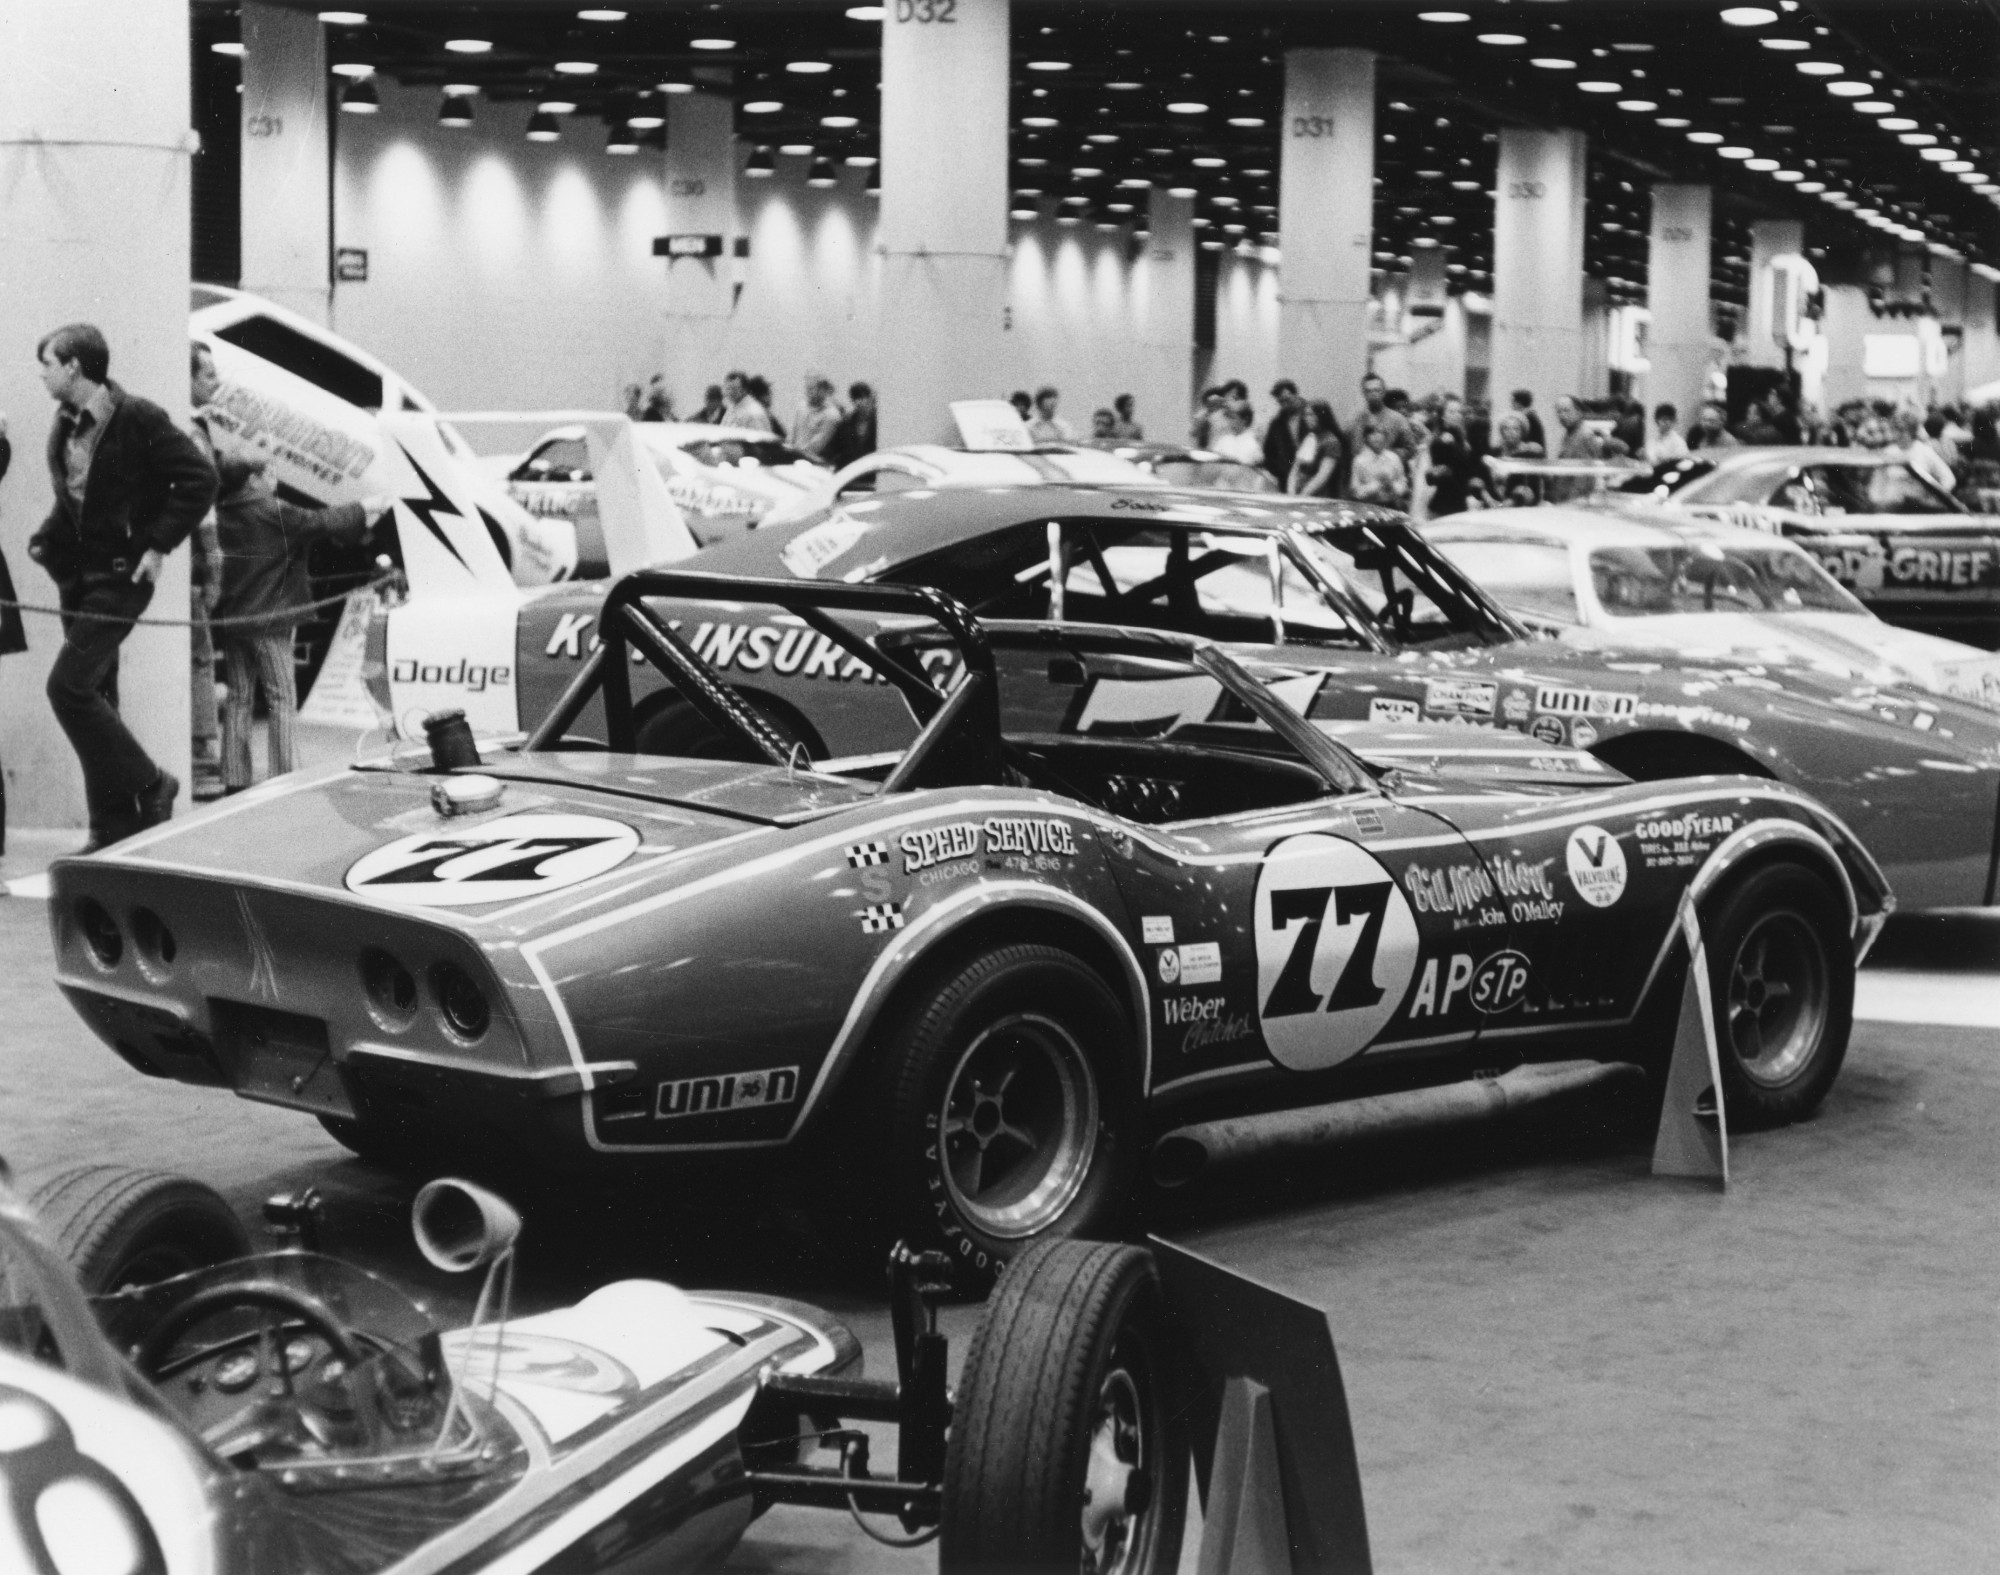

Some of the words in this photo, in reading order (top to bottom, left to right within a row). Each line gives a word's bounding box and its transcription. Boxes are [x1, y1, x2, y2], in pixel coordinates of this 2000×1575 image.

[897, 0, 956, 23] D32
[1892, 547, 1990, 584] GRIEF
[393, 657, 509, 692] Dodge
[1375, 701, 1414, 714] WIX
[1635, 813, 1734, 841] GOODYEAR
[900, 822, 979, 874] SPEED
[983, 817, 1078, 855] SERVICE
[357, 837, 622, 885] 77
[919, 860, 980, 887] CHICAGO
[1575, 865, 1622, 888] VALVOLINE
[1478, 906, 1508, 926] John
[1262, 881, 1394, 1019] 77
[1475, 958, 1528, 1004] STP
[1163, 996, 1225, 1024] Weber
